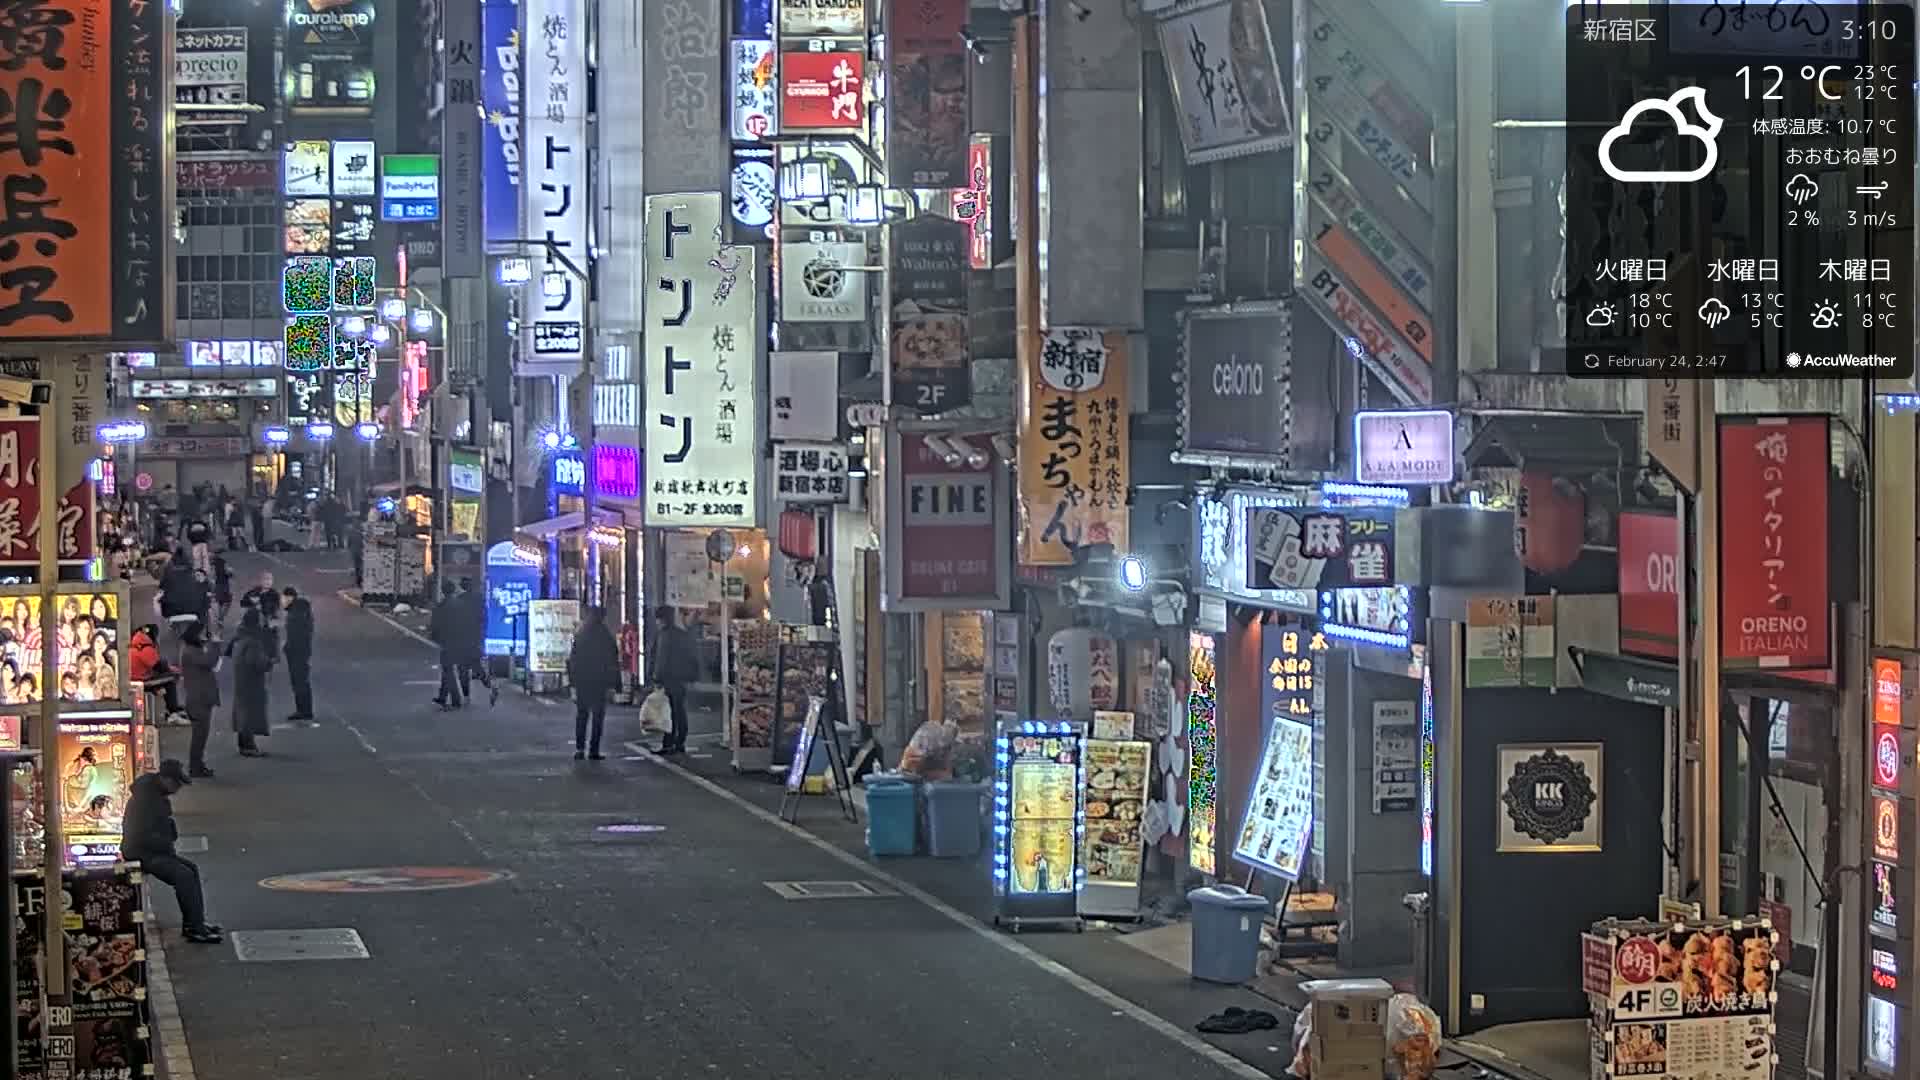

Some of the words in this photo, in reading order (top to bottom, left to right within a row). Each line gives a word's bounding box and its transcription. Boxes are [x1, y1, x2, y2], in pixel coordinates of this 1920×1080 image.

[830, 59, 859, 120] 牛門
[1314, 122, 1334, 142] 3
[386, 181, 435, 192] FamilyMart
[1311, 173, 1333, 192] 2
[406, 205, 434, 216] たばこ
[1311, 269, 1341, 298] B1
[660, 210, 692, 462] トントン
[1044, 338, 1102, 374] 新宿
[1064, 373, 1084, 390] の
[1212, 354, 1264, 396] celona
[916, 385, 946, 404] 2F
[779, 450, 843, 472] 酒場心
[1040, 396, 1084, 546] まっちゃん
[779, 475, 844, 494] 新宿本店
[911, 486, 986, 512] FINE
[1350, 519, 1390, 535] フリー
[1756, 432, 1789, 603] 俺のイタリアン
[1741, 615, 1807, 633] ORENO
[1739, 636, 1808, 651] ITALIAN
[1534, 783, 1564, 799] KK
[1618, 990, 1651, 1013] 4F
